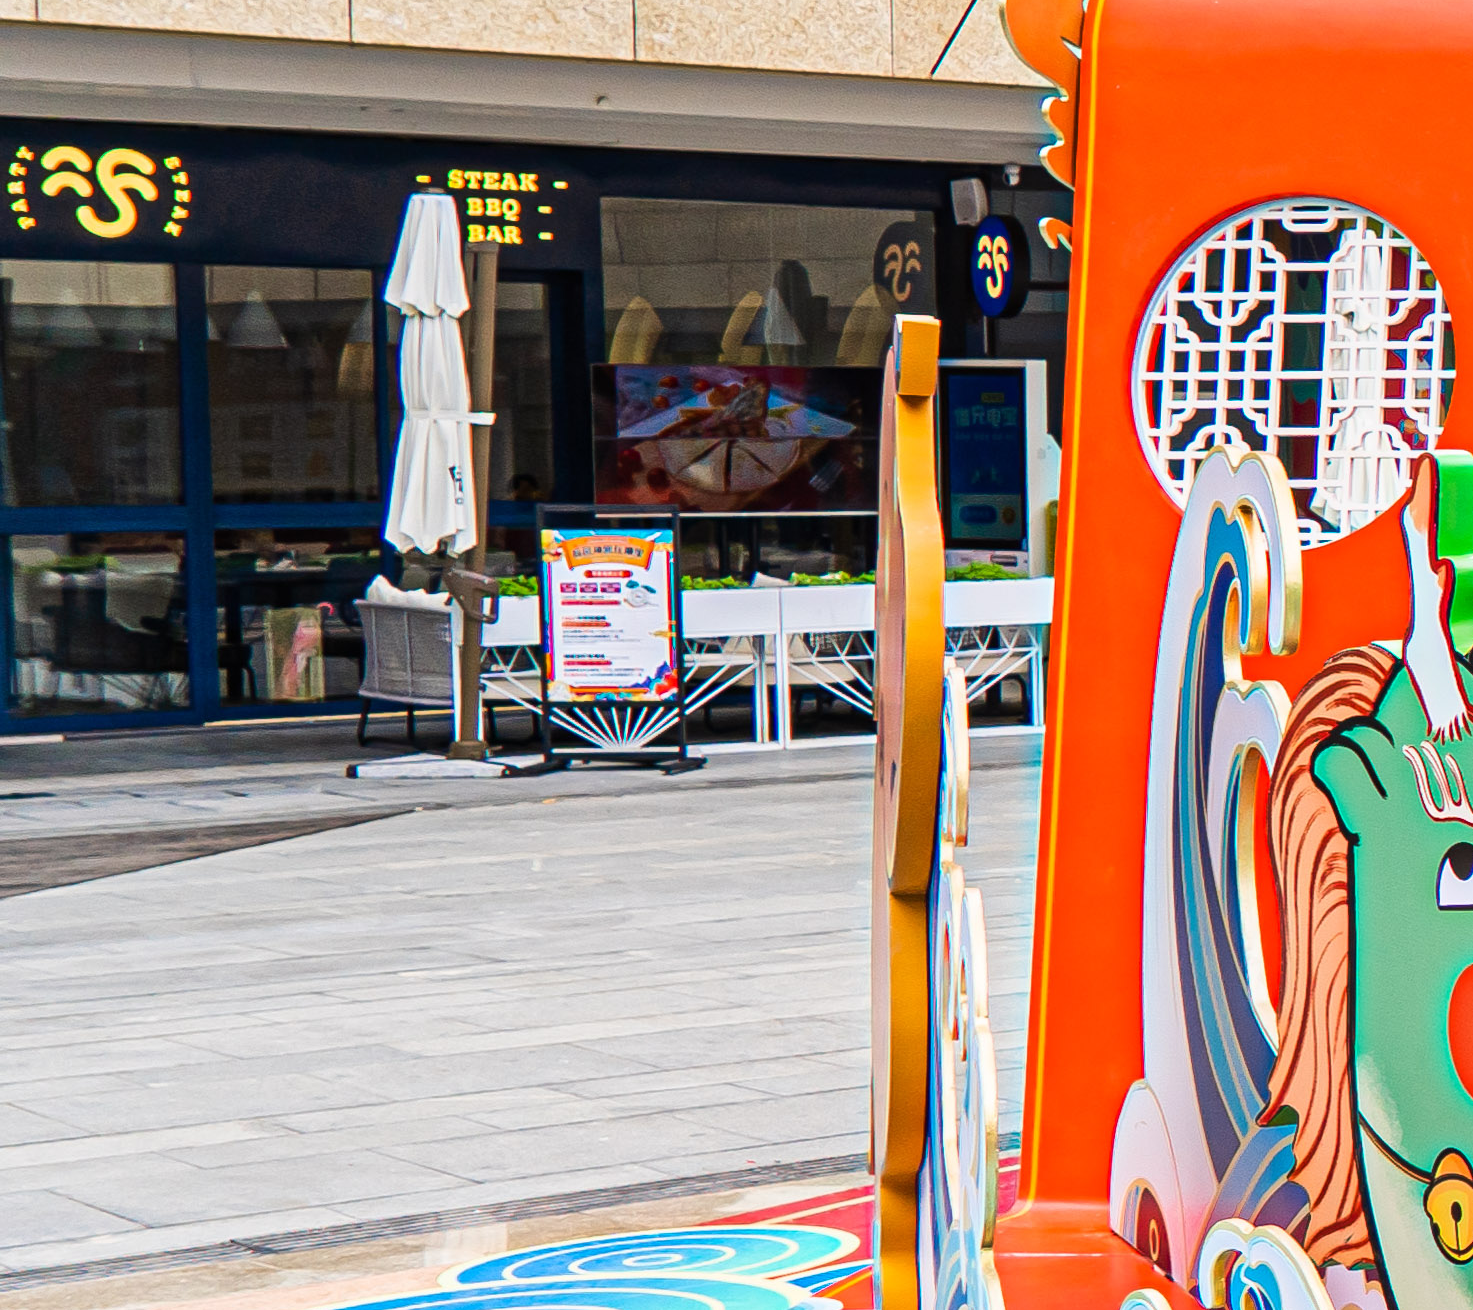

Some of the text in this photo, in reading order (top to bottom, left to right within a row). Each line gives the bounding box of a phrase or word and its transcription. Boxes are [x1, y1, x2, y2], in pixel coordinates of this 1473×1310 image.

[7, 145, 37, 231] PARTY
[447, 169, 540, 193] STEAK
[163, 156, 192, 238] STEAK
[465, 197, 521, 222] BBQ
[467, 225, 523, 245] BAR
